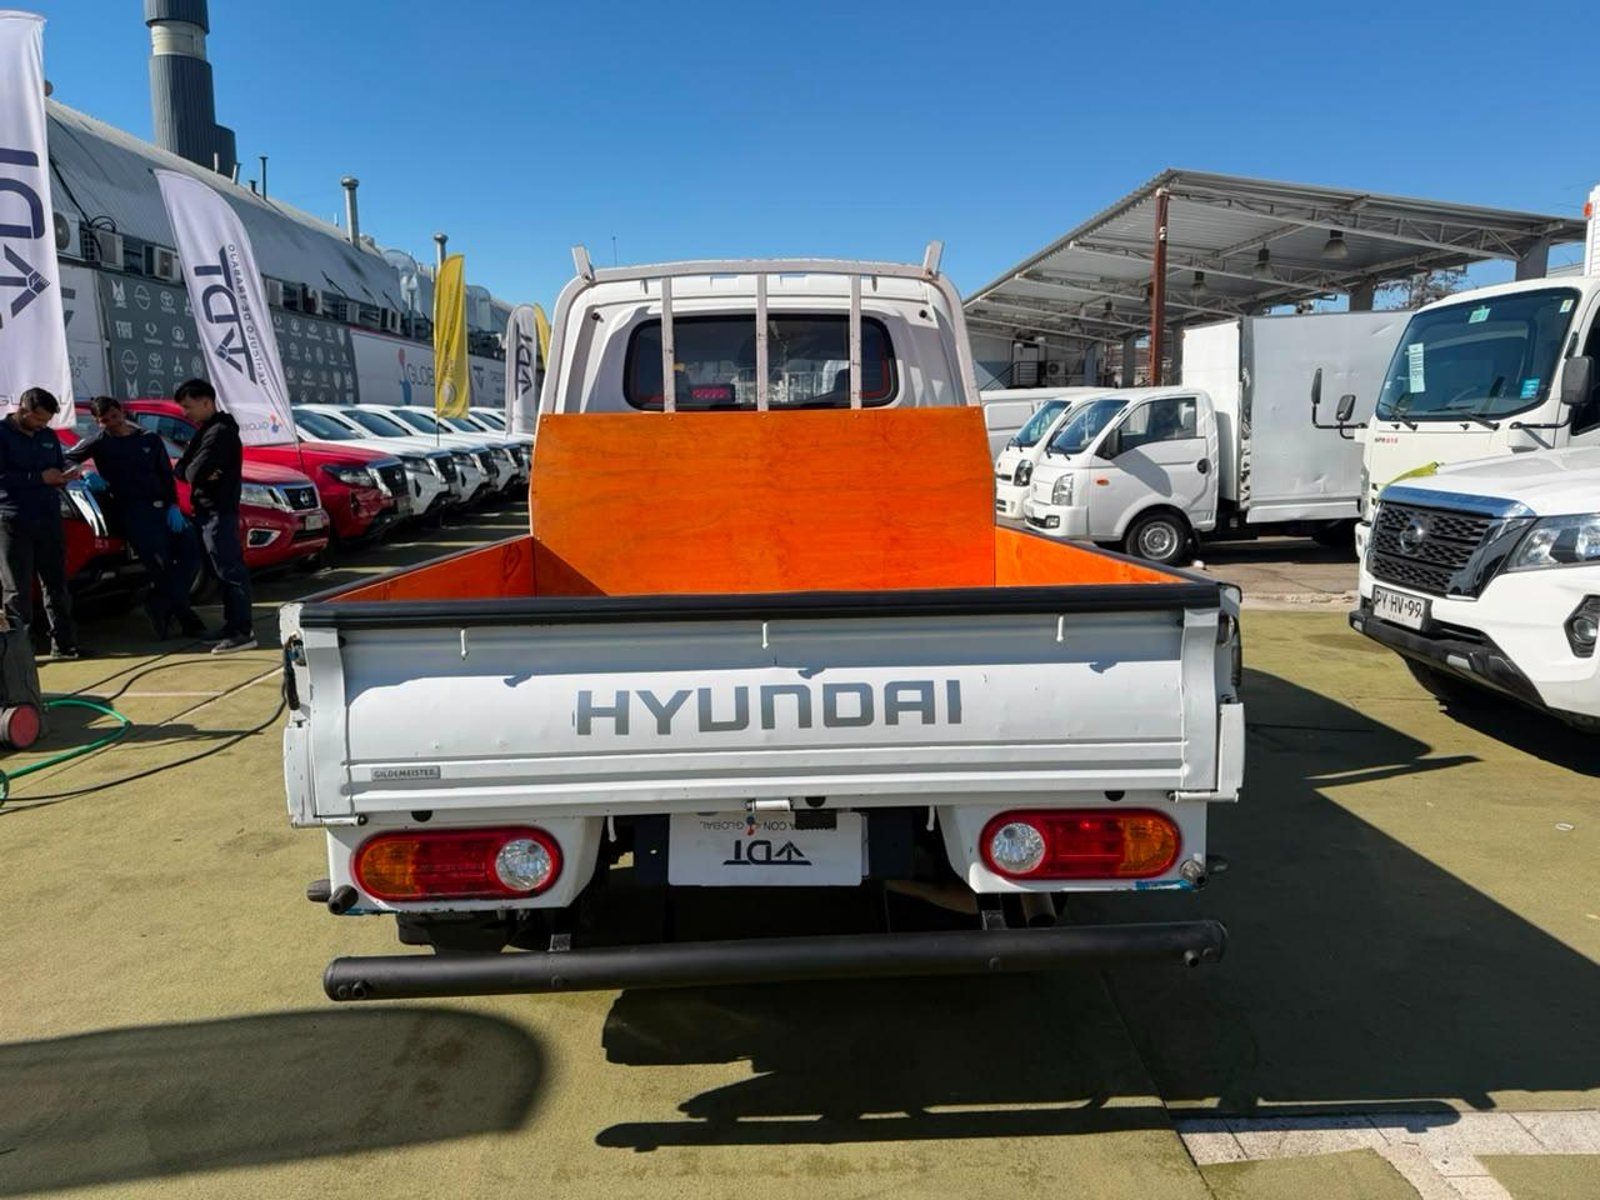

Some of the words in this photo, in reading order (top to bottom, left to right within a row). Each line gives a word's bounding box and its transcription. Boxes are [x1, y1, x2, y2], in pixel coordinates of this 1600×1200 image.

[577, 680, 961, 736] HYUNDAI
[374, 769, 435, 778] GILDEMEISTER
[700, 820, 744, 831] GLOBAL
